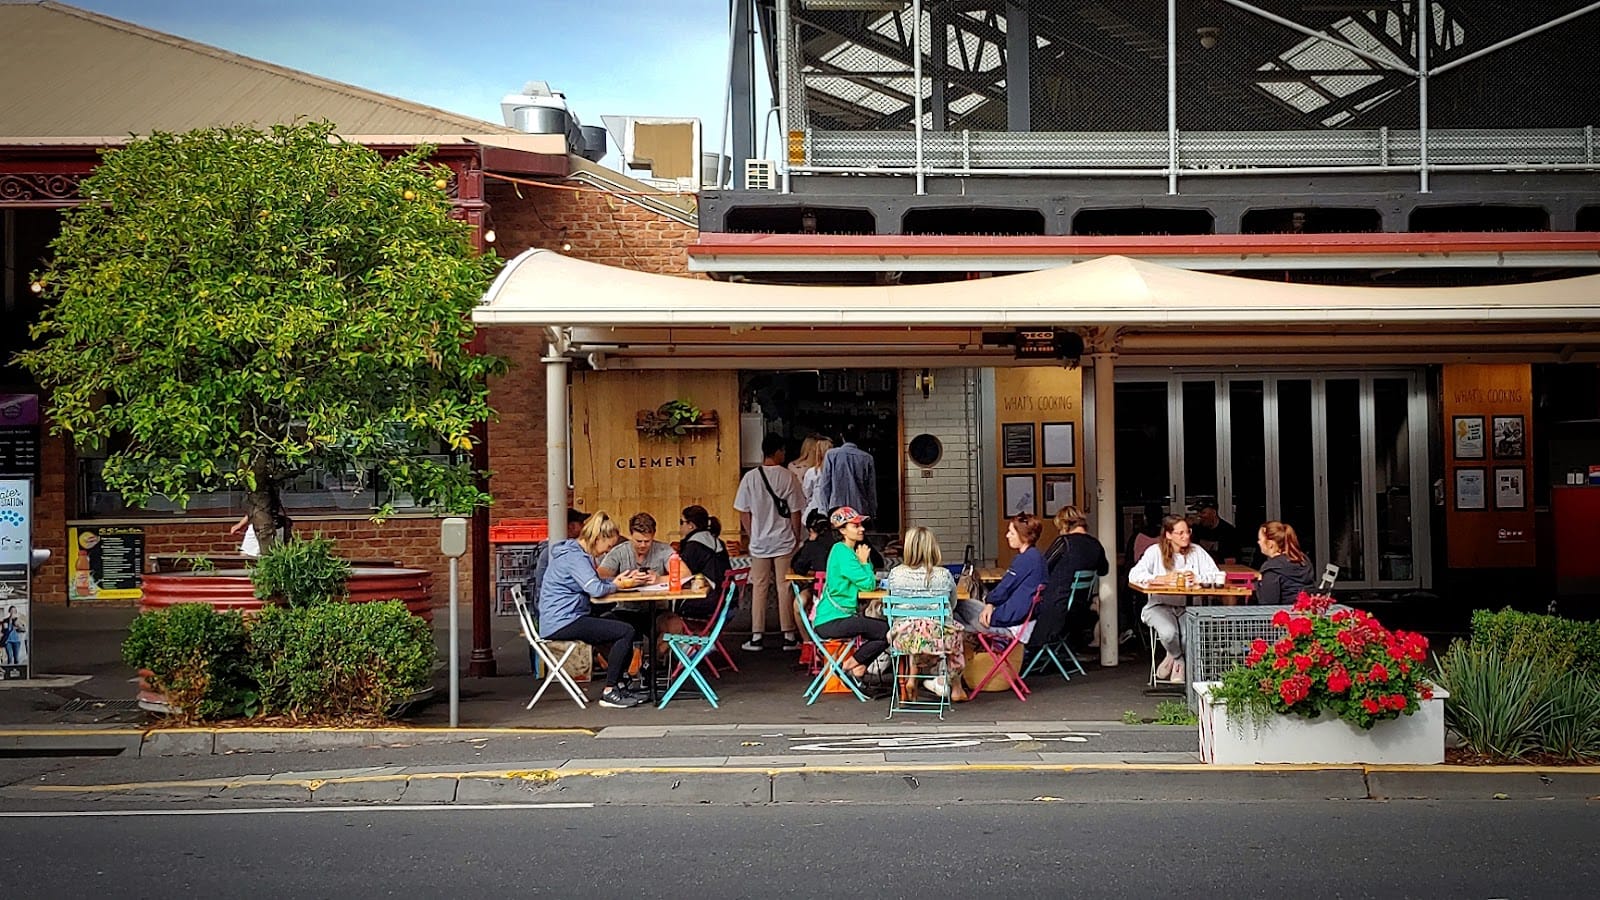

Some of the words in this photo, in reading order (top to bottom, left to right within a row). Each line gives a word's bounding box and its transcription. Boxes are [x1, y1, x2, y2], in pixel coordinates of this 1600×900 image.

[1004, 394, 1033, 411] WHAT'S
[1038, 394, 1073, 411] COOKING
[1487, 388, 1522, 404] COOKING
[616, 456, 697, 469] CLEMENT
